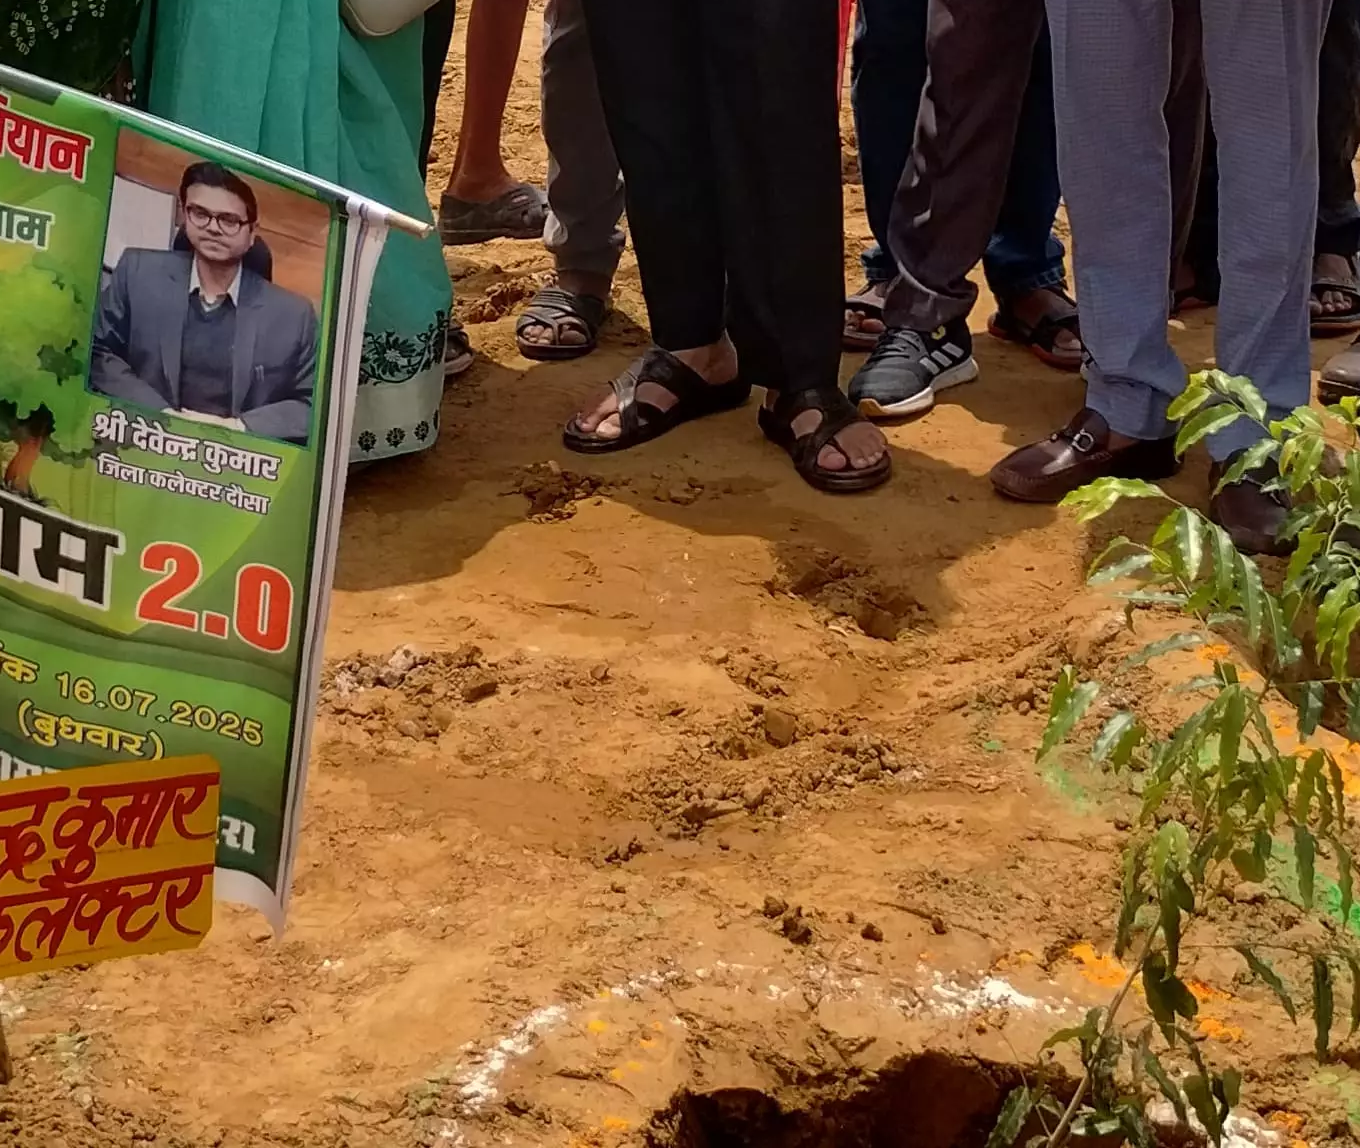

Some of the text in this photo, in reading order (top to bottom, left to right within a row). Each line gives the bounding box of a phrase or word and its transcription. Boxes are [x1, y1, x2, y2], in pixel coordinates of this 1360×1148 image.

[93, 410, 282, 482] श्री देवेन्द्र कुमार
[96, 452, 273, 516] जिला कलेक्टर दौसा
[136, 540, 295, 654] 2.0
[17, 698, 166, 762] (बुधवार)
[54, 670, 265, 749] 16.07.2025
